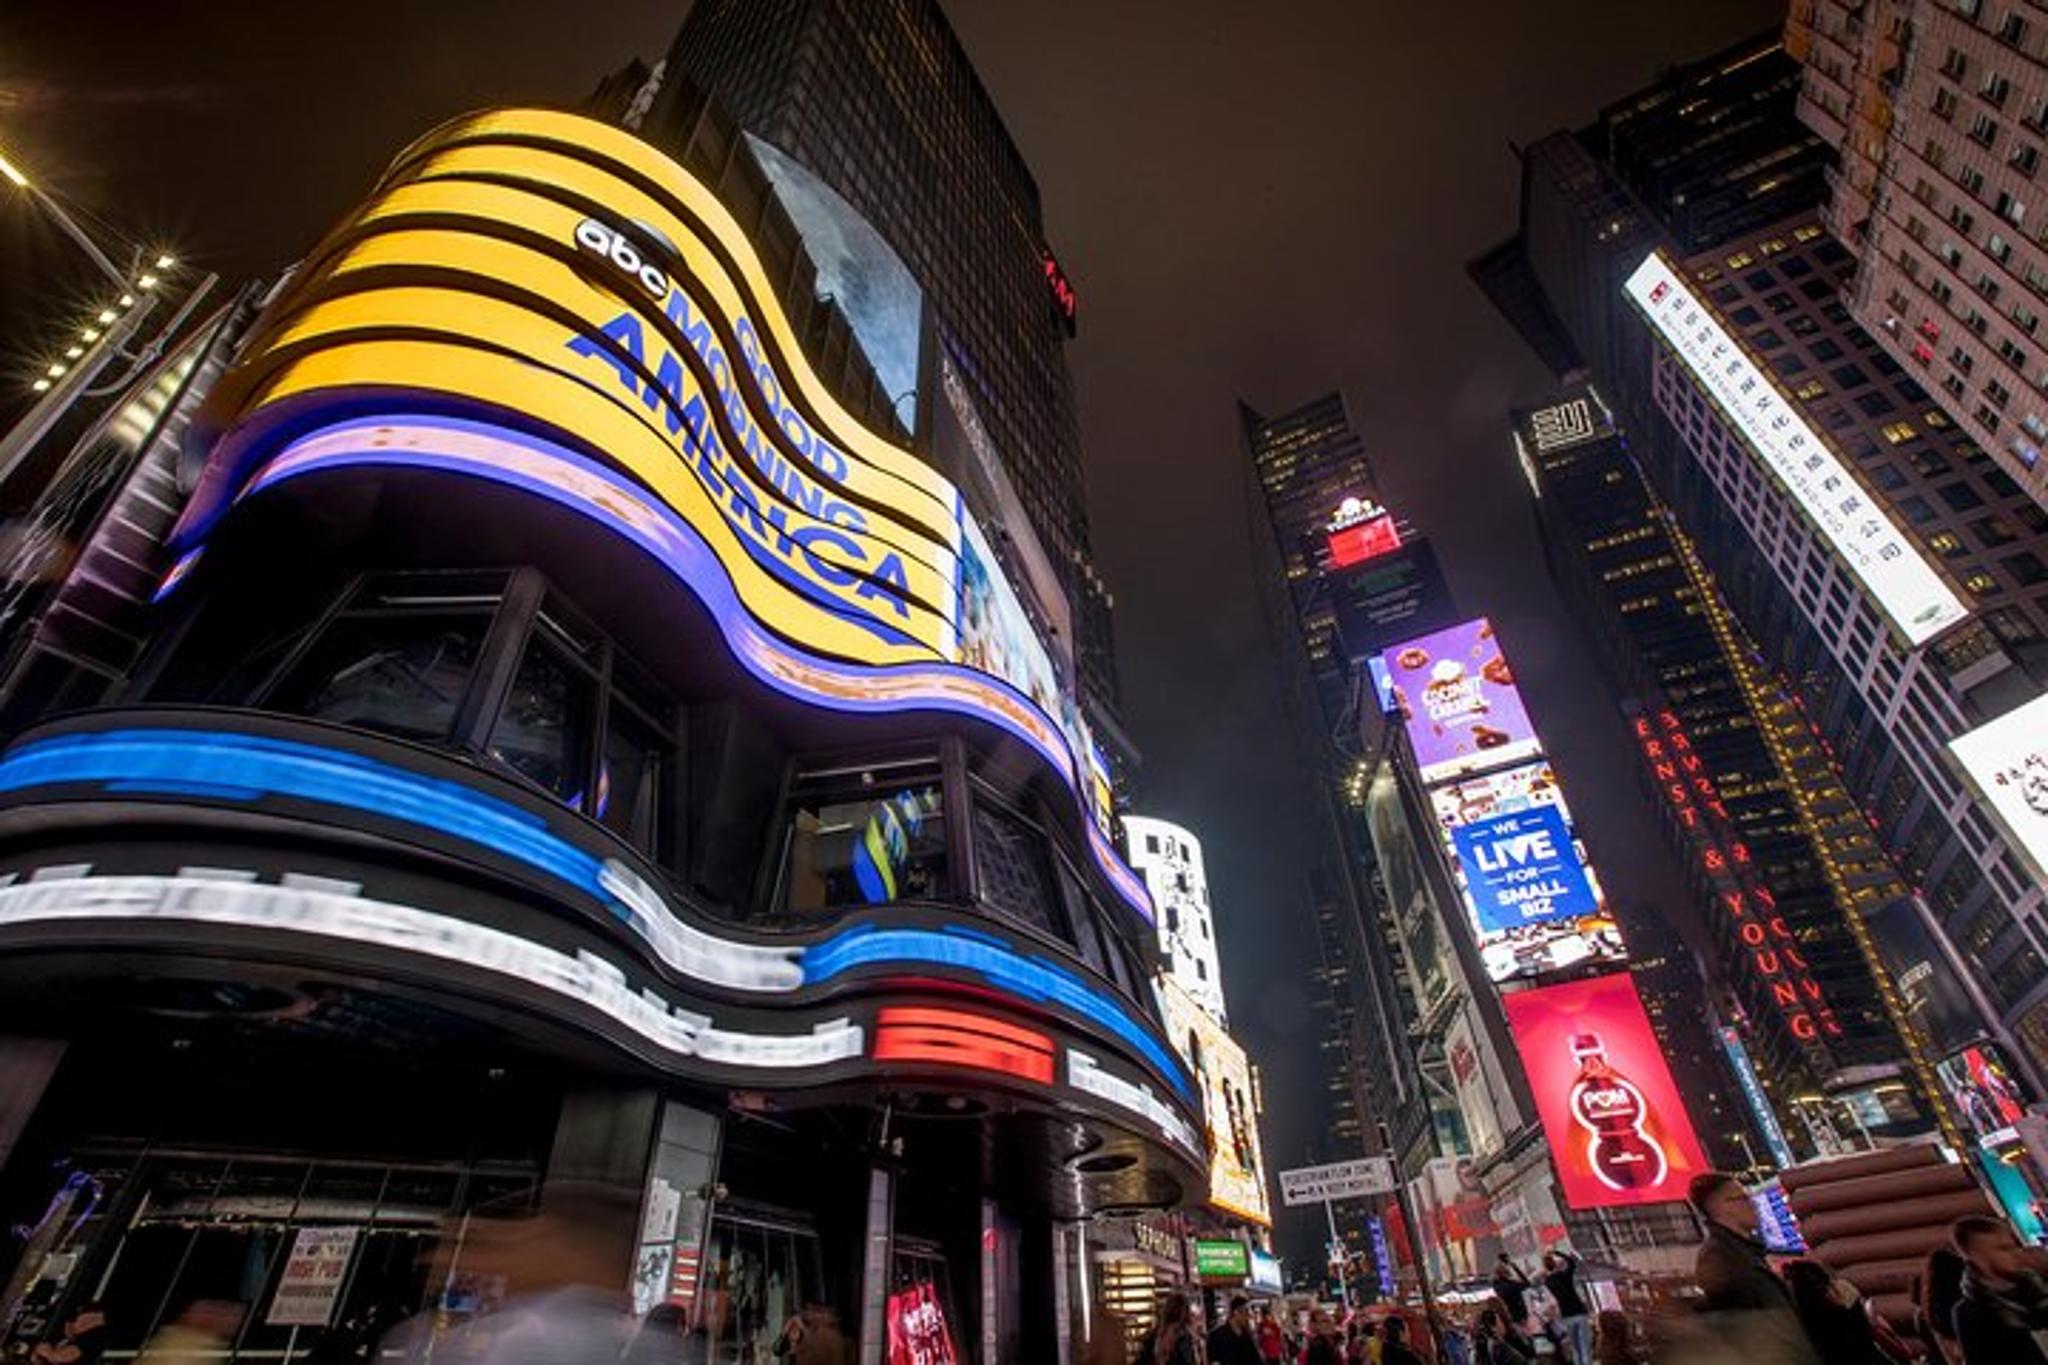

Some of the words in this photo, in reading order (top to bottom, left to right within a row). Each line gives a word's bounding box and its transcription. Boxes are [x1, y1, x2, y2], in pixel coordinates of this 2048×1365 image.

[577, 219, 667, 297] abc
[665, 289, 870, 535] MORNING
[735, 316, 849, 485] GOOD
[564, 311, 911, 619] AMERICA
[1492, 818, 1520, 835] WE
[1473, 830, 1557, 872] LIVE
[1496, 879, 1568, 906] SMALL
[1506, 867, 1541, 885] FOR
[1636, 717, 1696, 828] ERNST
[1705, 843, 1725, 869] &
[1726, 891, 1817, 1040] YOUNG
[1519, 898, 1555, 918] BIZ
[1583, 1088, 1630, 1109] POM
